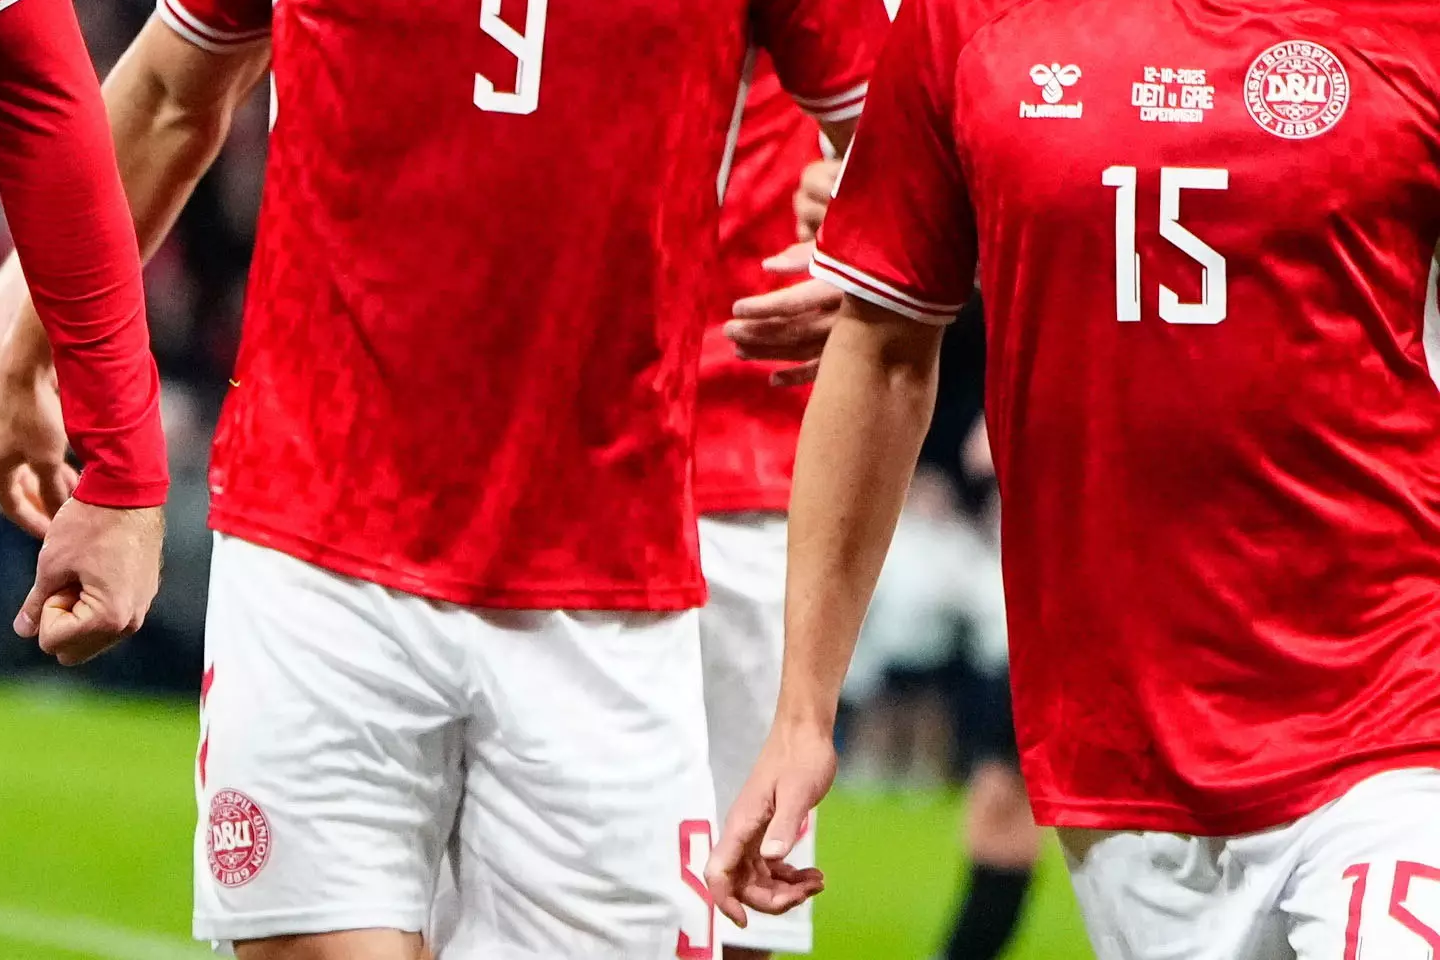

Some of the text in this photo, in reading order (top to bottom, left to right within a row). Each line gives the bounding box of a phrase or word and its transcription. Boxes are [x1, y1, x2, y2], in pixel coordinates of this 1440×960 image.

[1131, 82, 1165, 107] DEN
[1181, 85, 1215, 109] GRE
[1265, 73, 1327, 103] DBU
[1102, 166, 1228, 324] 15
[213, 820, 252, 852] DBU
[1342, 860, 1440, 960] 15
